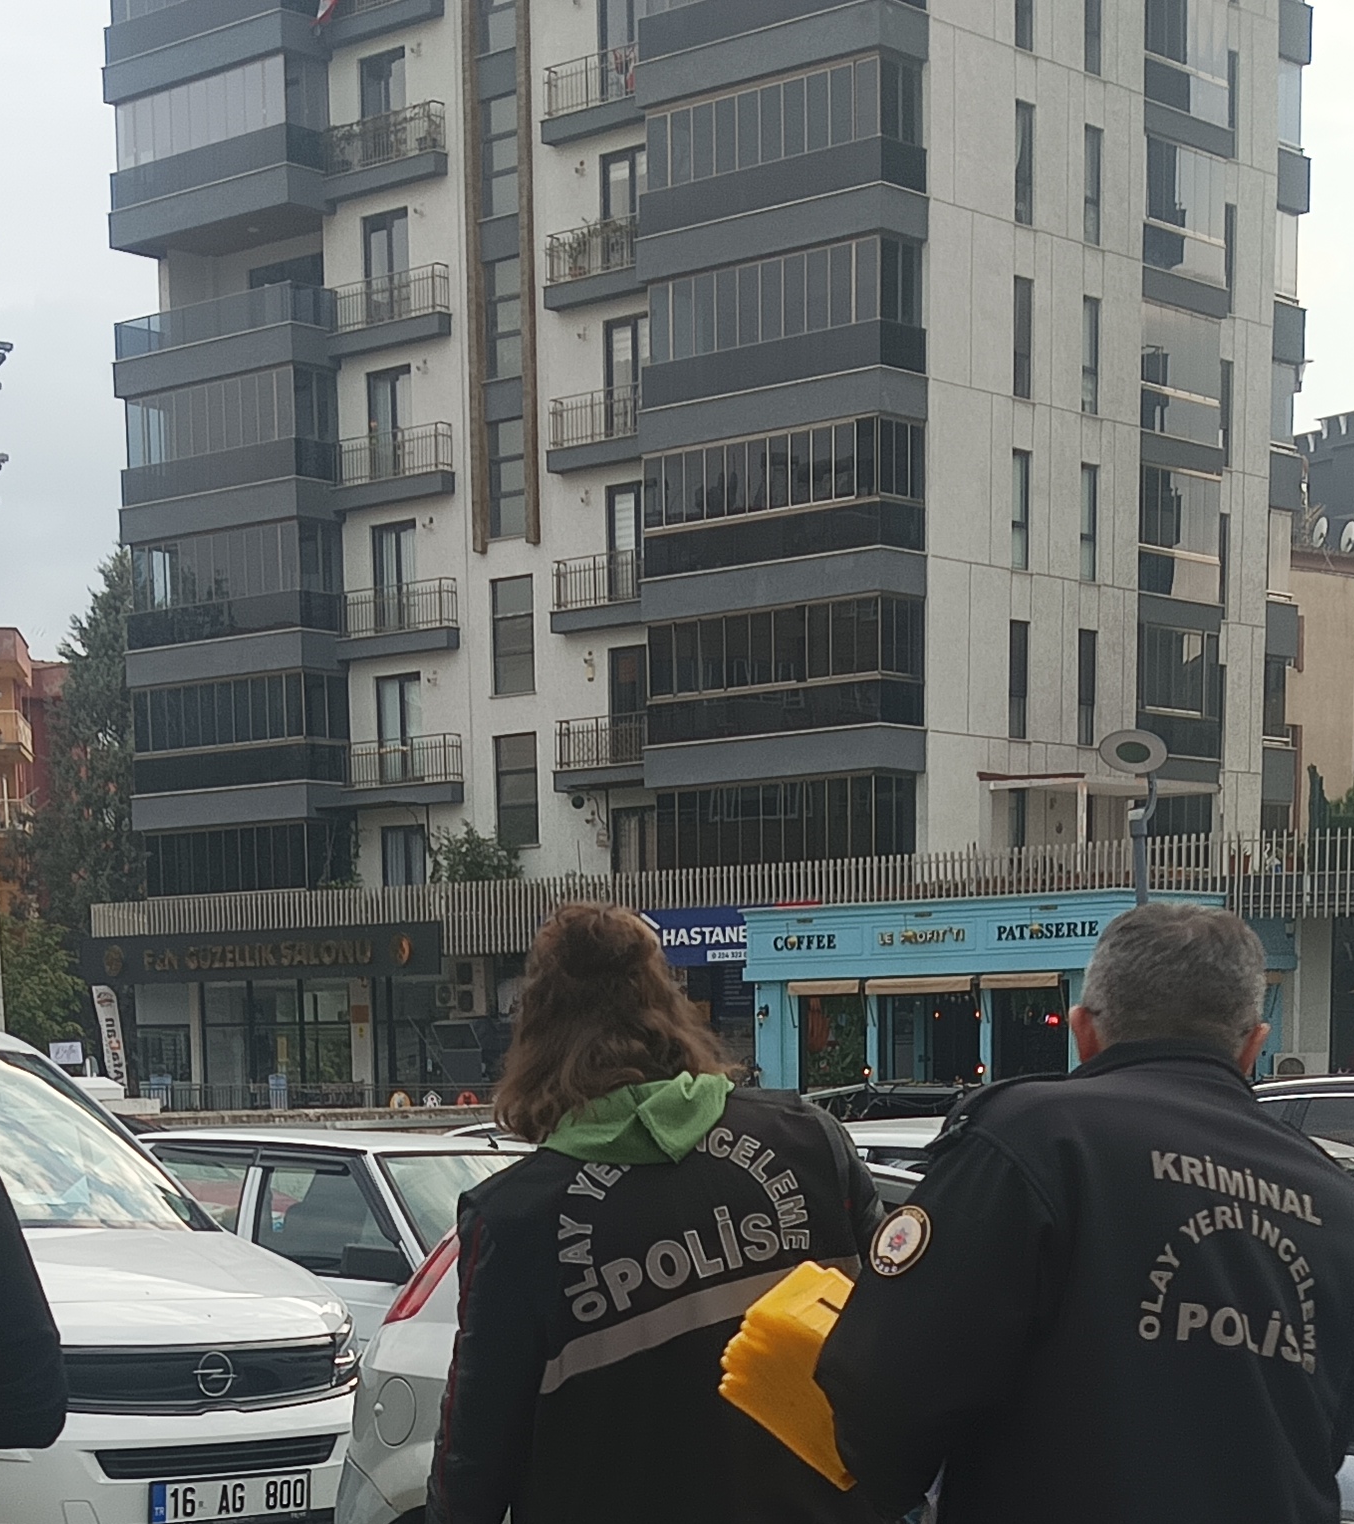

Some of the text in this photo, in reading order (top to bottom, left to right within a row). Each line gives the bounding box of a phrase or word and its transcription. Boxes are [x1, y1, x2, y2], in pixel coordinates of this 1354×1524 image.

[280, 937, 372, 967] SALONU
[773, 933, 836, 952] COFFEE
[878, 931, 893, 946] LE
[1151, 1150, 1323, 1227] KRİMİNAL
[558, 1214, 607, 1322] OLAY
[1138, 1243, 1181, 1341] OLAY
[1179, 1202, 1244, 1244] YERİ
[154, 1478, 305, 1519] TR 16 AG 800
